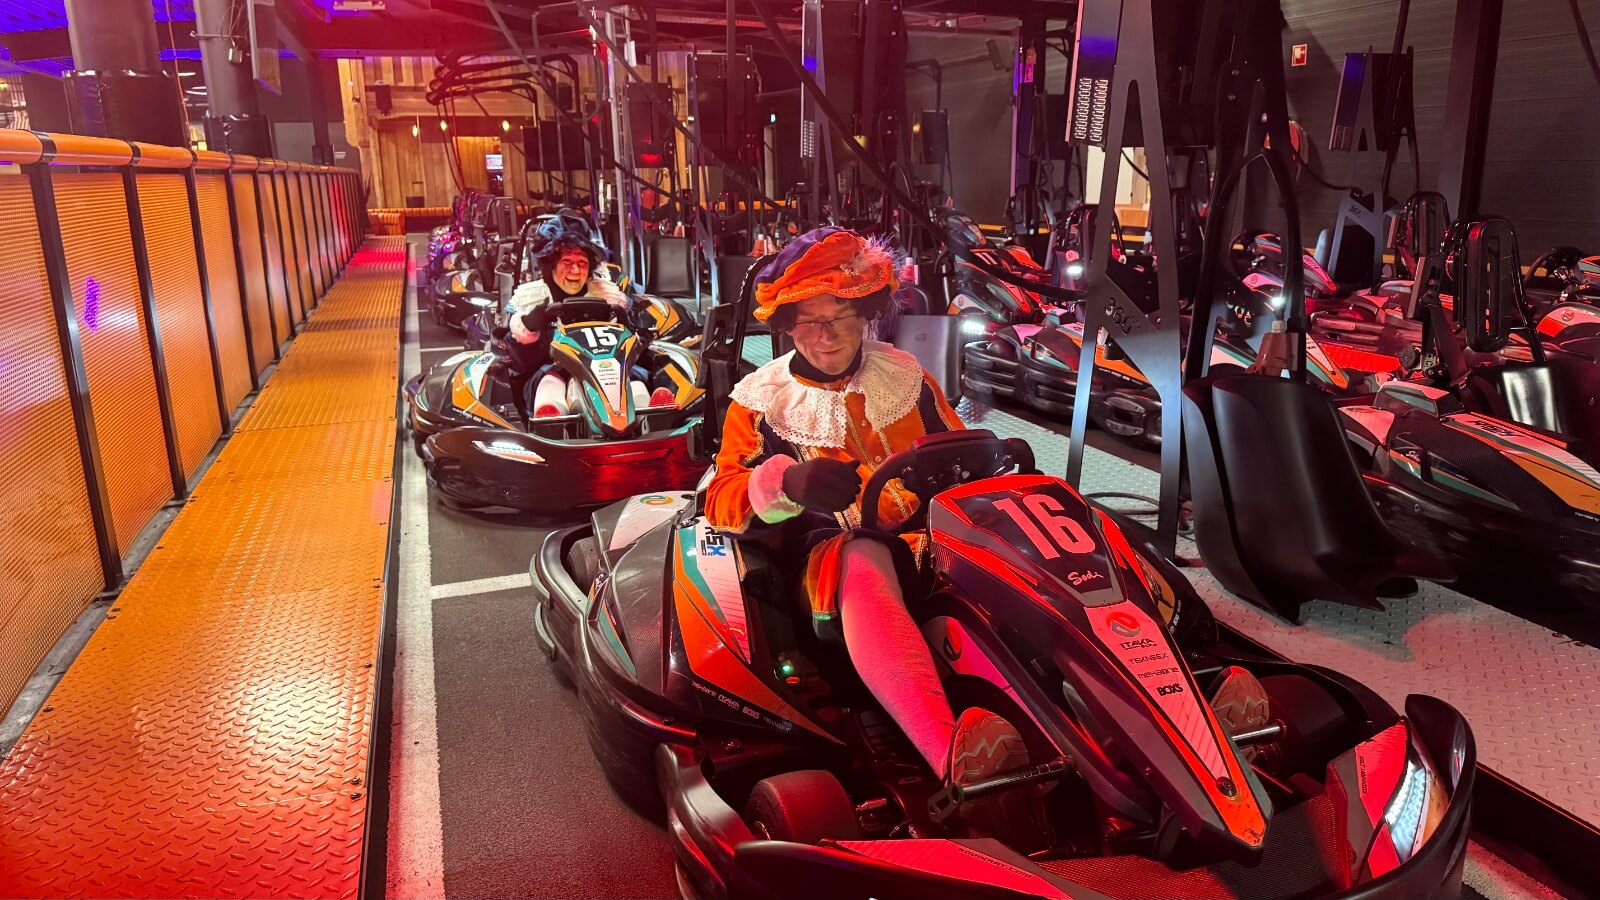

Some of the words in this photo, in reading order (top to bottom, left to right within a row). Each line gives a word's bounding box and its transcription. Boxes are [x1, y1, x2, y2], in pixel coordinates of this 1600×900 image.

[580, 326, 618, 348] 15
[991, 493, 1096, 560] 16
[1067, 570, 1105, 586] Sodi
